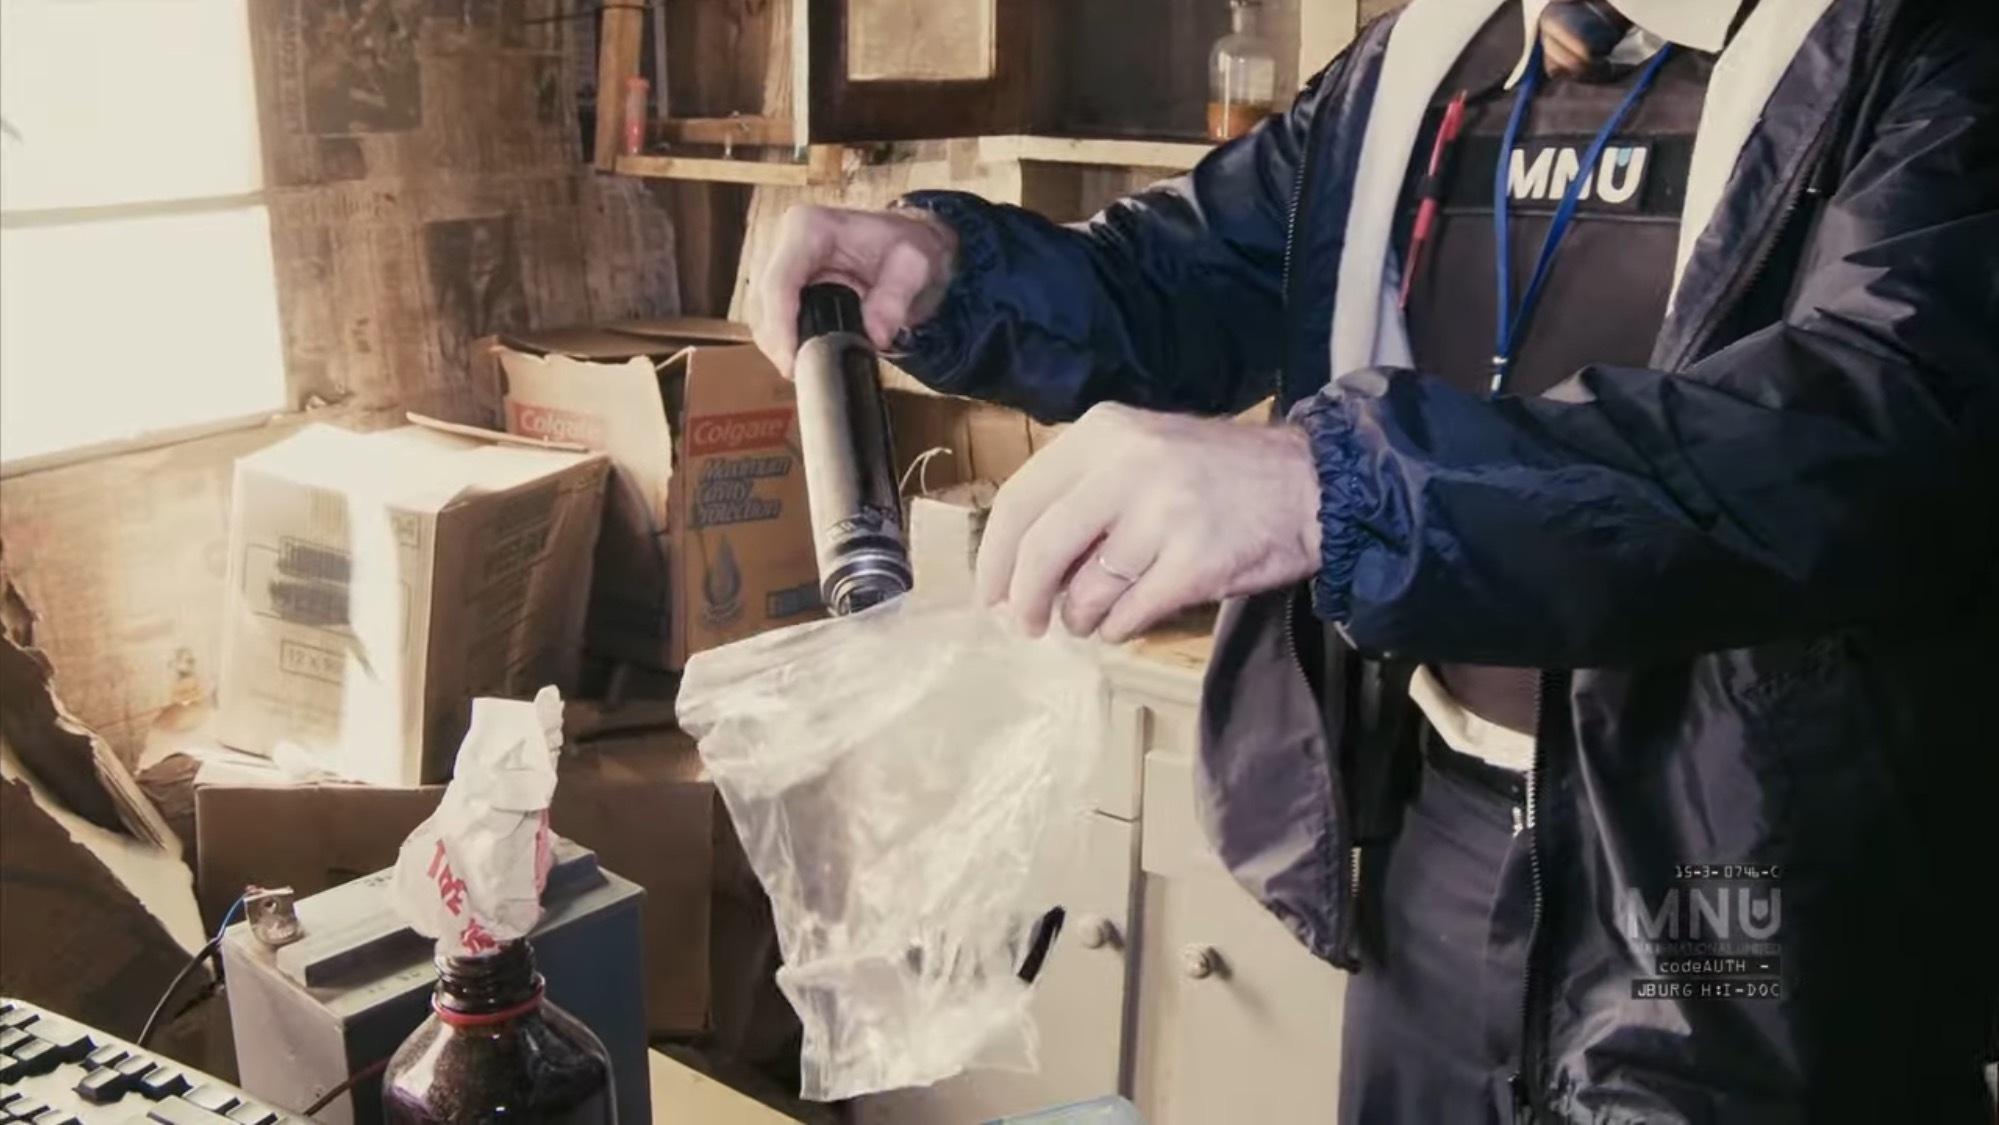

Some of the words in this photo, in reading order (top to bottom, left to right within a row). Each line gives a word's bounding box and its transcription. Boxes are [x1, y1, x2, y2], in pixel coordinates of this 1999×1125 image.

[1507, 146, 1647, 204] MNU
[520, 407, 600, 442] Colgate
[694, 417, 784, 447] Colgate
